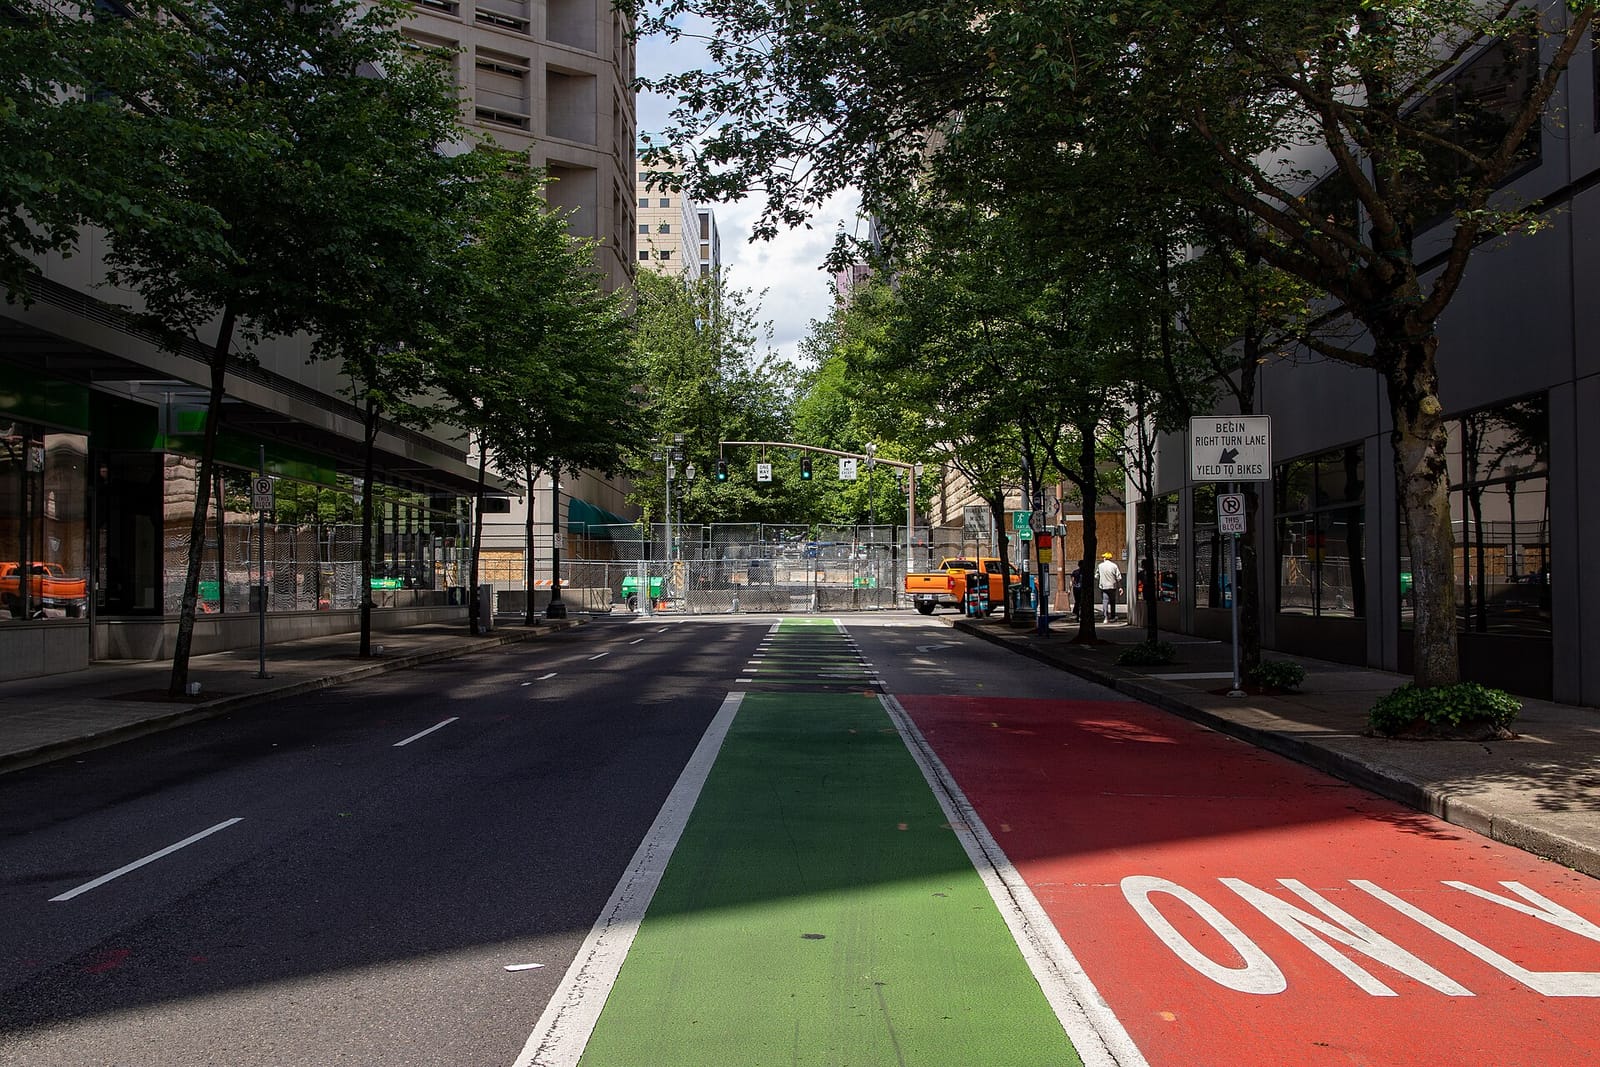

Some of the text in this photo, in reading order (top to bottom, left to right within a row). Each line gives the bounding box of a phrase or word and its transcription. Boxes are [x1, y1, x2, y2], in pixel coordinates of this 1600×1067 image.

[1216, 423, 1245, 433] BEGIN
[1195, 435, 1266, 446] RIGHT TURN LANE
[1196, 464, 1262, 475] YIELD TO BIKES
